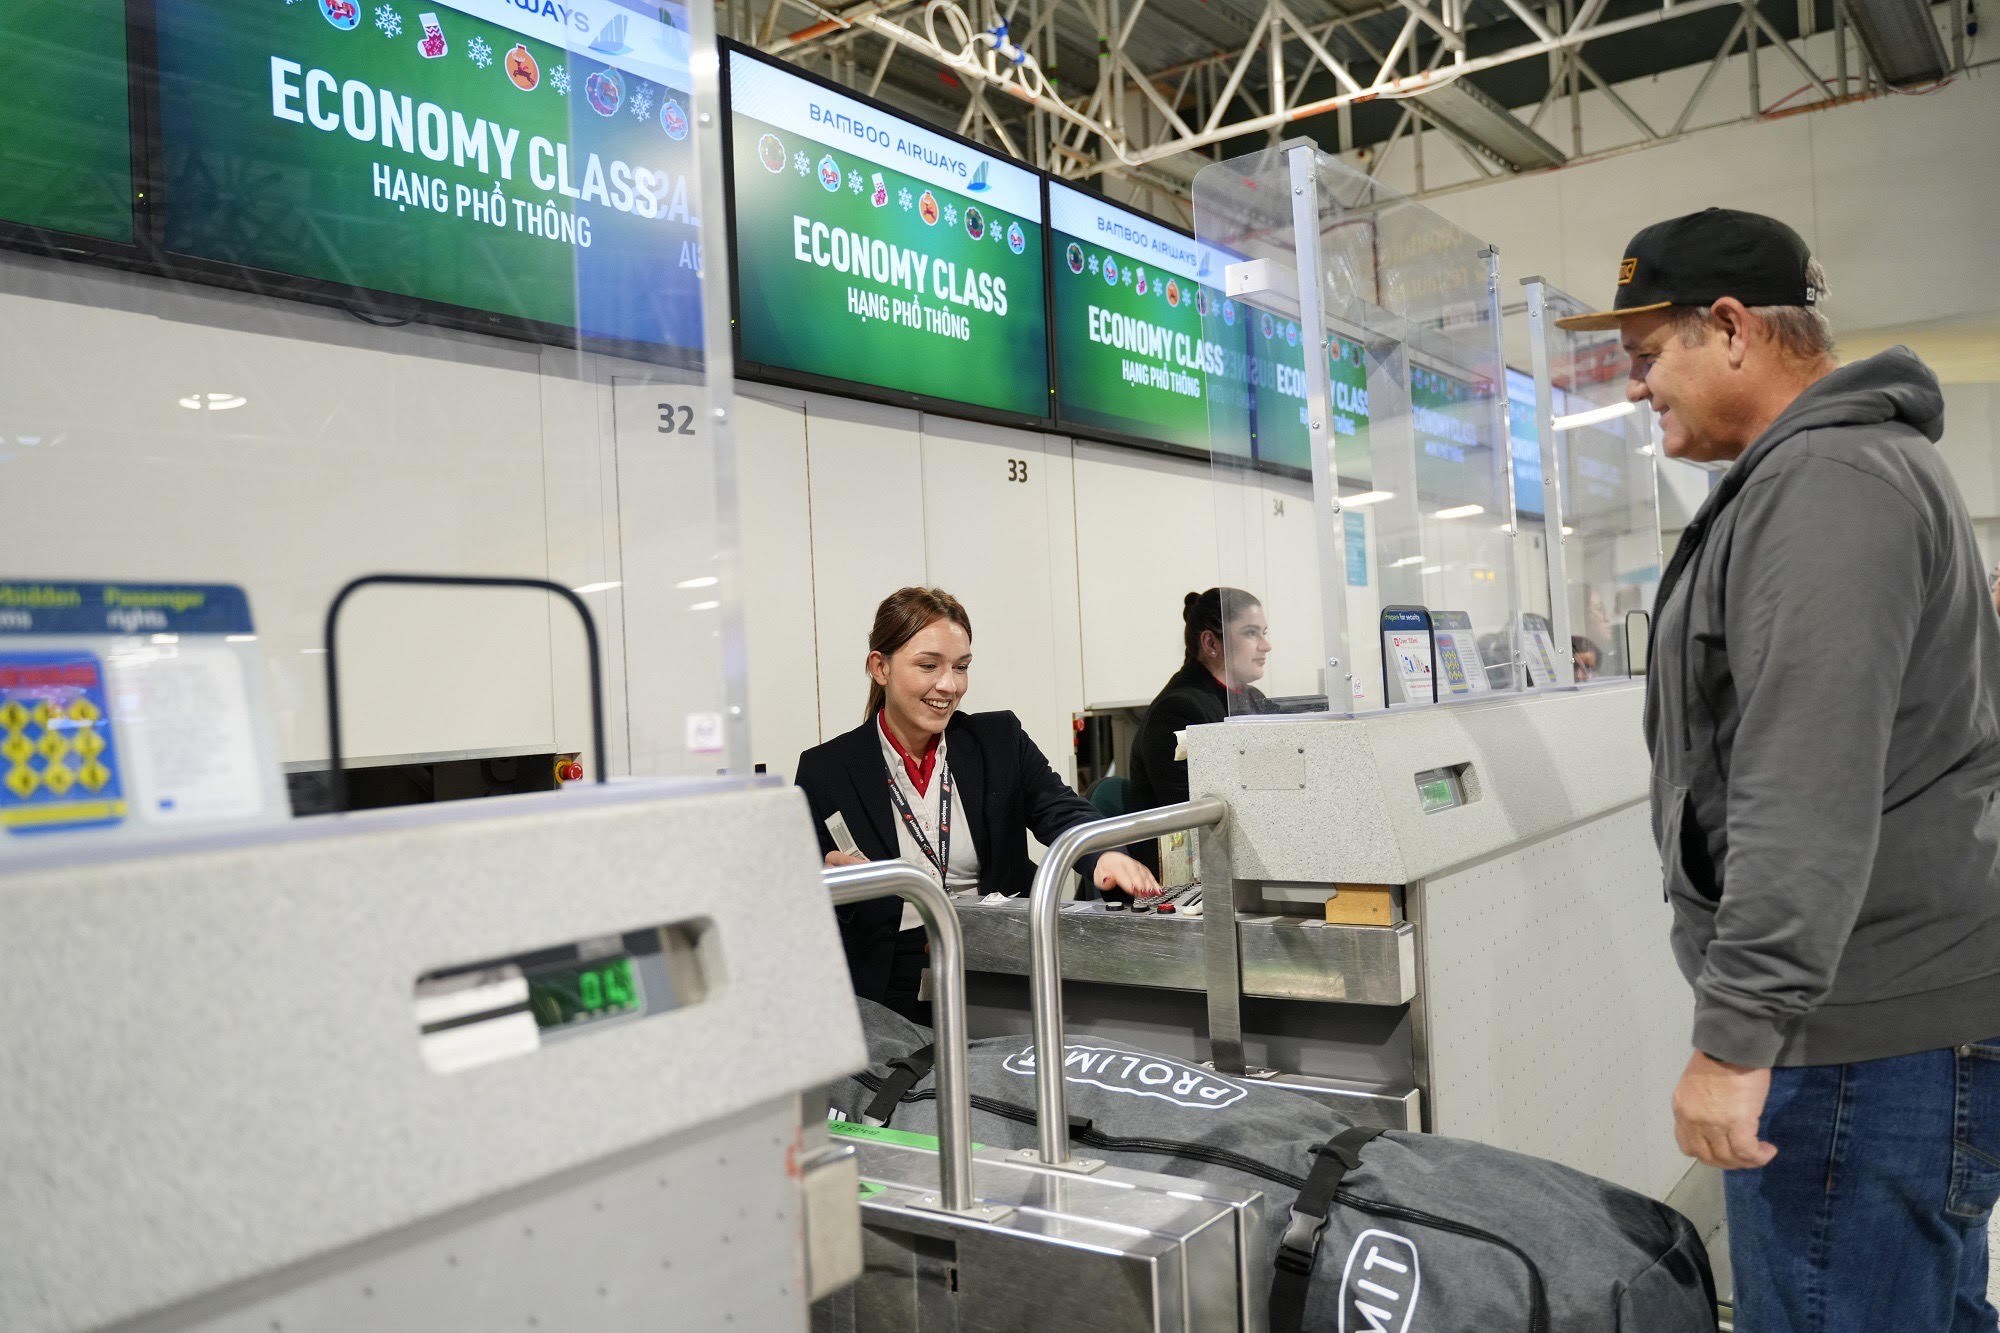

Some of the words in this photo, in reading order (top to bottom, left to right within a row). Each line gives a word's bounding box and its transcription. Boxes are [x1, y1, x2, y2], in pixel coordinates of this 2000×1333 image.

[271, 55, 520, 180] ECONOMY
[528, 135, 658, 219] CLASS
[809, 103, 890, 148] BAMBOO
[897, 138, 967, 177] AIRWAYS
[372, 162, 449, 213] HẠNG
[455, 180, 507, 228] PHỔ
[512, 198, 592, 248] THÔNG
[793, 215, 929, 294] ECONOMY
[932, 258, 1008, 316] CLASS
[1097, 216, 1148, 248] BAMBOO
[1151, 239, 1198, 267] AIRWAYS
[847, 286, 889, 323] HẠNG
[892, 294, 922, 330] PHỔ
[923, 305, 970, 341] THÔNG
[1088, 305, 1173, 362] ECONOMY
[1175, 332, 1224, 376] CLASS
[1122, 359, 1149, 387] HẠNG
[1150, 362, 1170, 392] PHỔ
[1170, 370, 1200, 398] THÔNG
[657, 403, 696, 435] 32
[1008, 459, 1028, 483] 33
[1272, 498, 1285, 518] 34
[1018, 1050, 1231, 1100] PROLIMT
